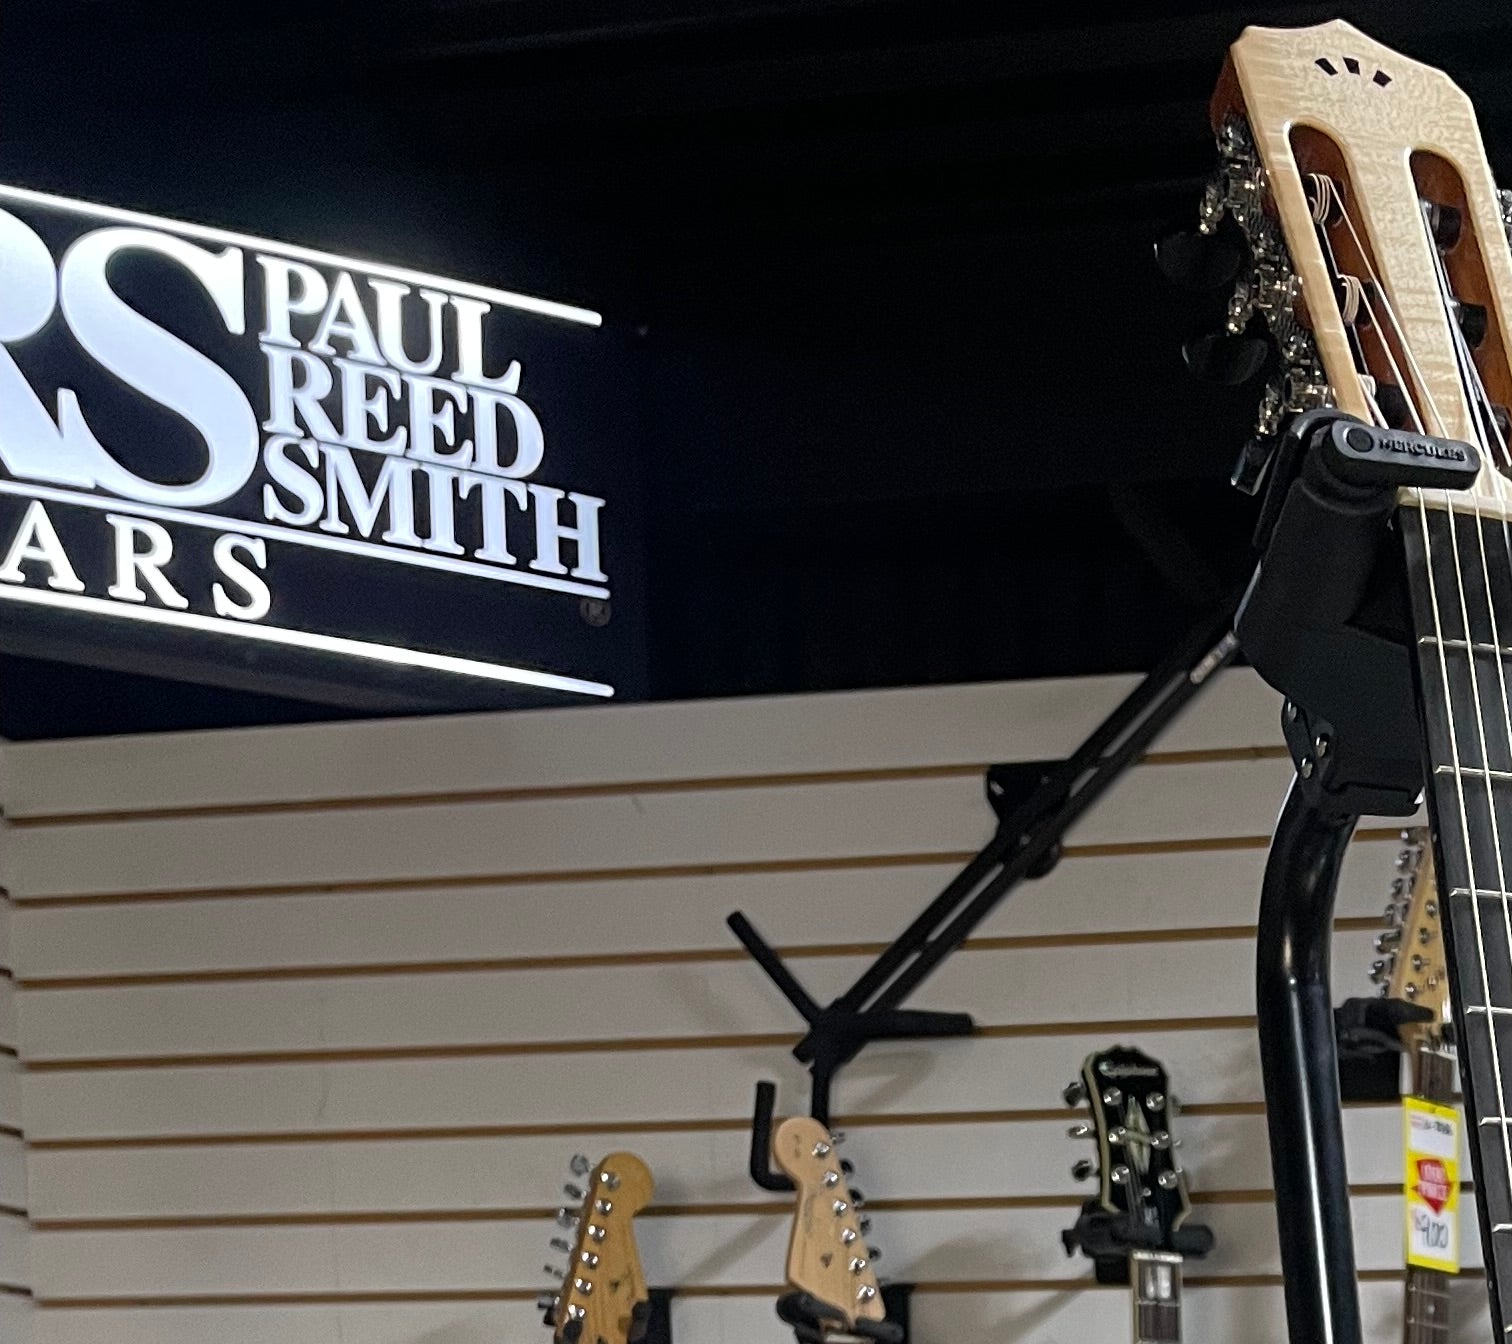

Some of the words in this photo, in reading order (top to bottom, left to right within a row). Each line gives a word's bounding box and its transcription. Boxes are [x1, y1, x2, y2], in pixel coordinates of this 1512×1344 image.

[256, 253, 522, 395] PAUL
[259, 342, 546, 481] REED
[1378, 436, 1467, 463] HERCULES
[262, 435, 609, 583] SMITH
